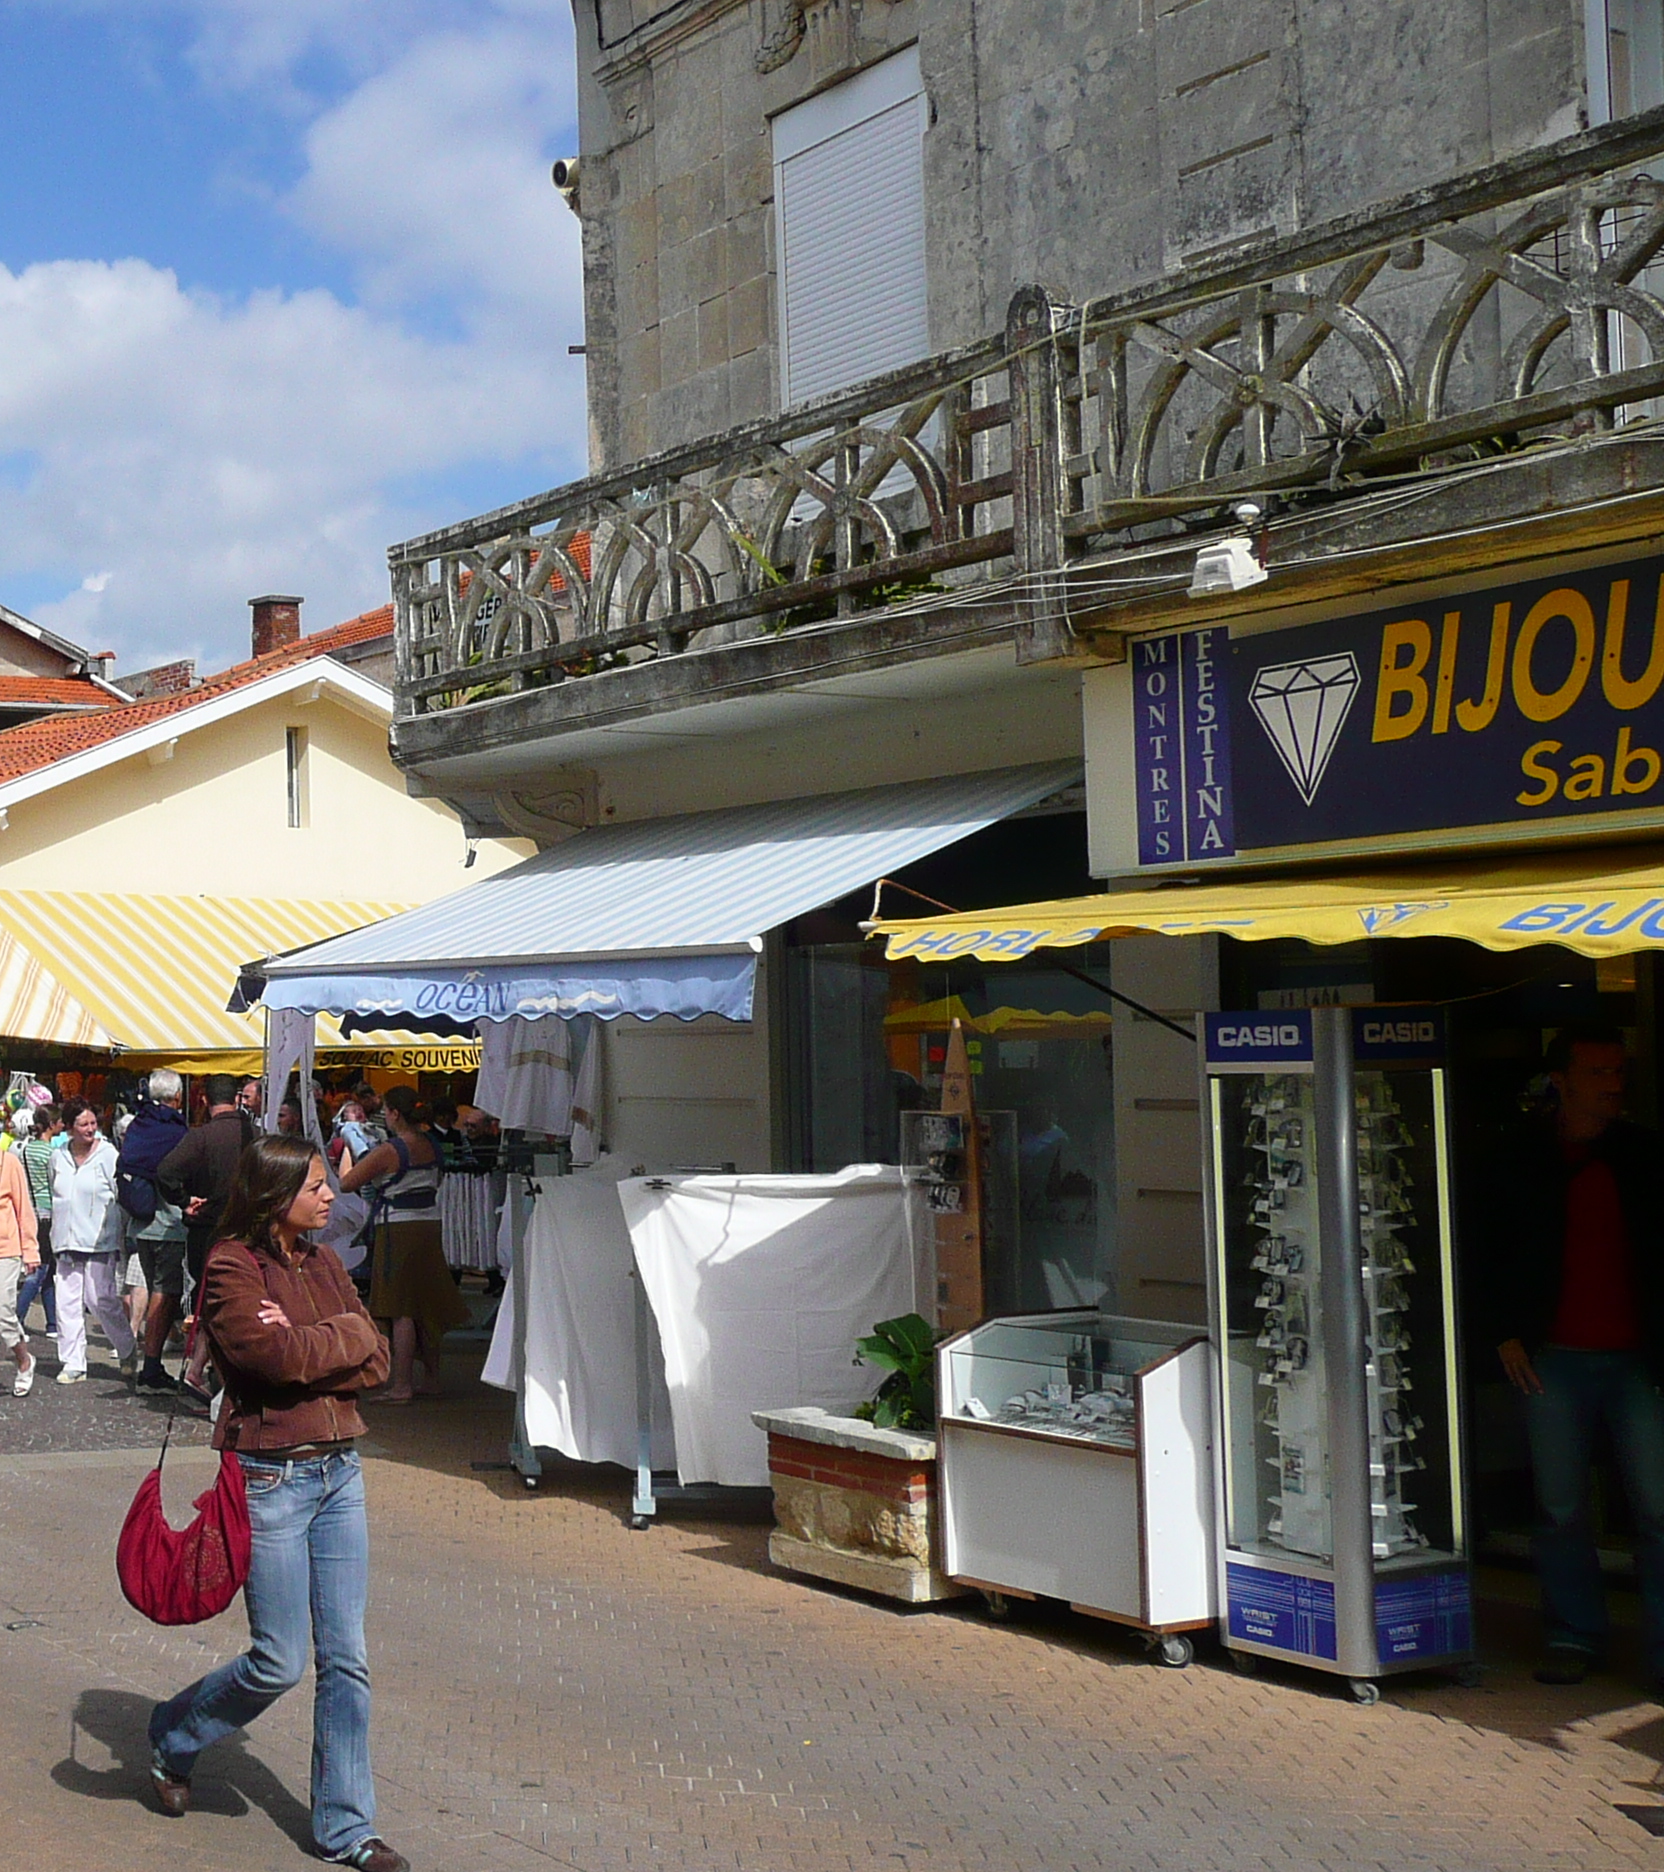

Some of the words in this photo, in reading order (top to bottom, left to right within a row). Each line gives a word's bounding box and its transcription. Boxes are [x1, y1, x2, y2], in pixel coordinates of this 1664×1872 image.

[1143, 639, 1171, 855] MONTRES
[1194, 630, 1224, 850] FESTINA
[1515, 727, 1661, 807] Sab
[1217, 1024, 1299, 1047] CASIO
[1363, 1021, 1435, 1044] CASIO
[319, 1050, 394, 1067] SOULAC
[1246, 1624, 1273, 1637] CASIO
[1393, 1641, 1417, 1652] CASIO
